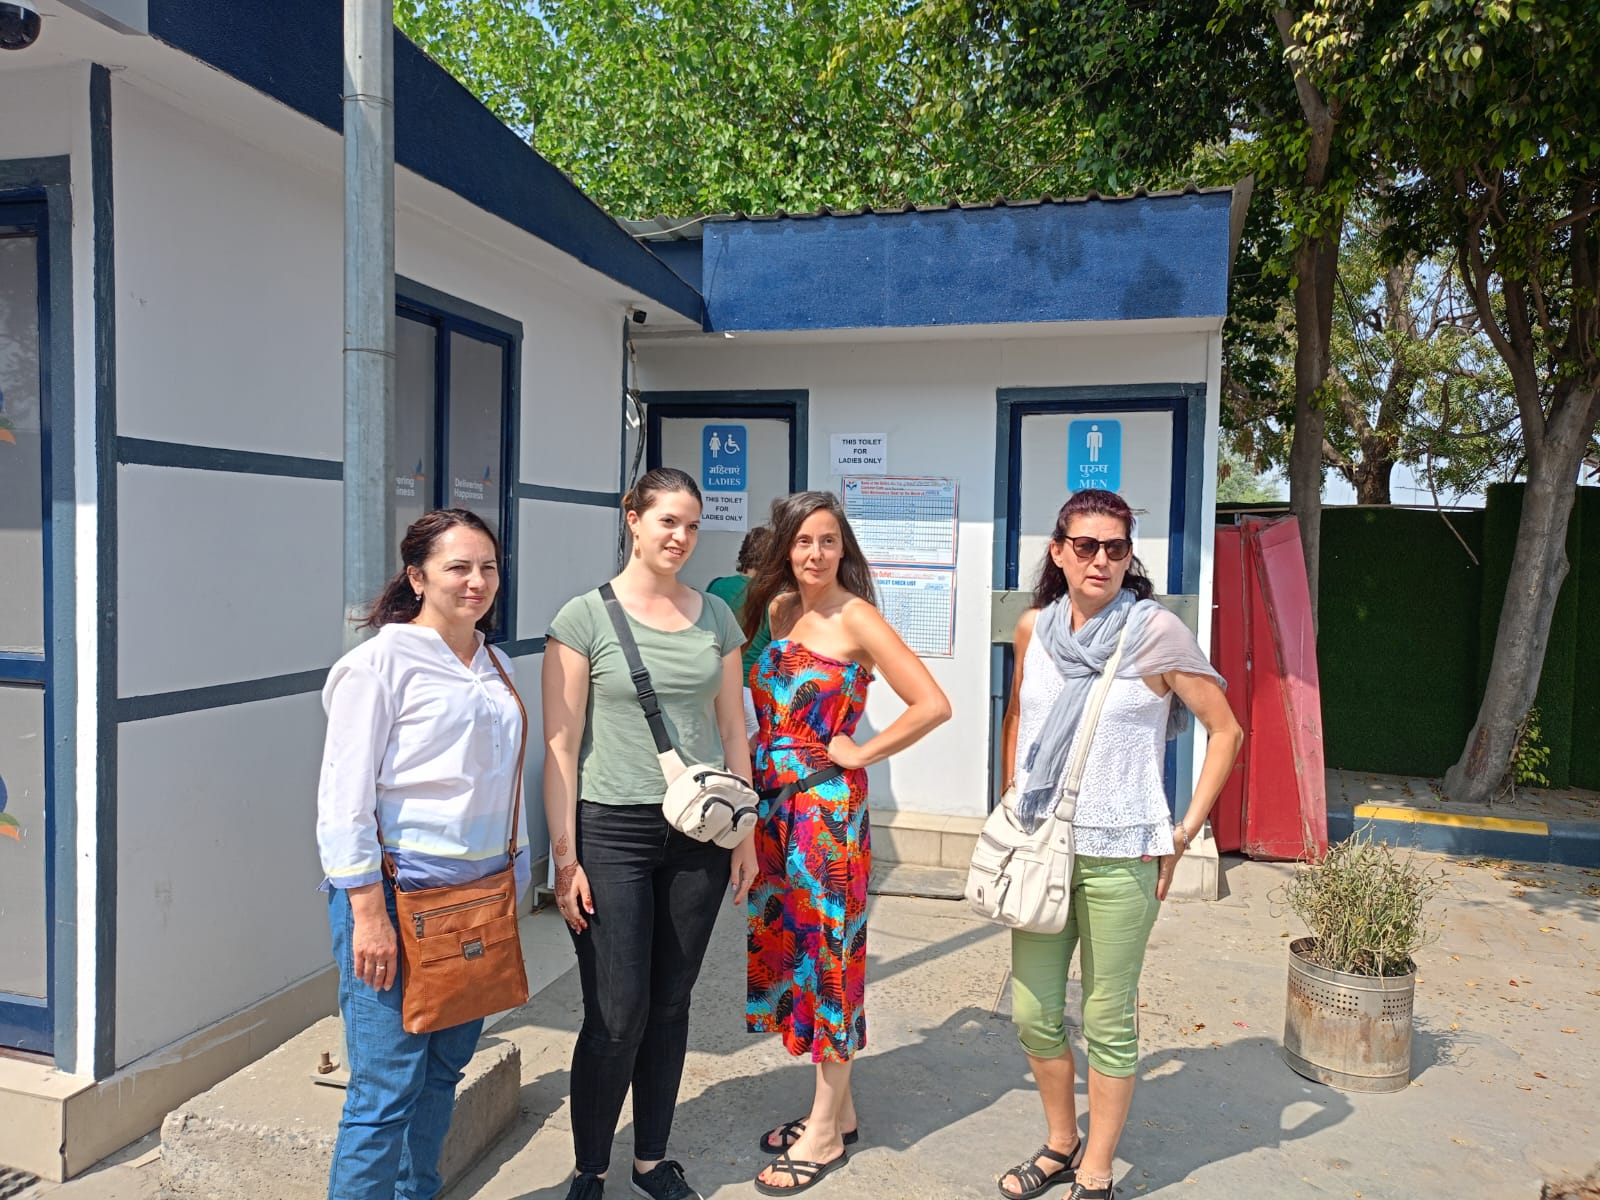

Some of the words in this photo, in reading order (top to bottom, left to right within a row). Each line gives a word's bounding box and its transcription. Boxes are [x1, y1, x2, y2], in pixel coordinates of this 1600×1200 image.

[1079, 464, 1108, 477] पुरुष
[708, 477, 741, 486] LADIES
[1079, 479, 1108, 489] MEN
